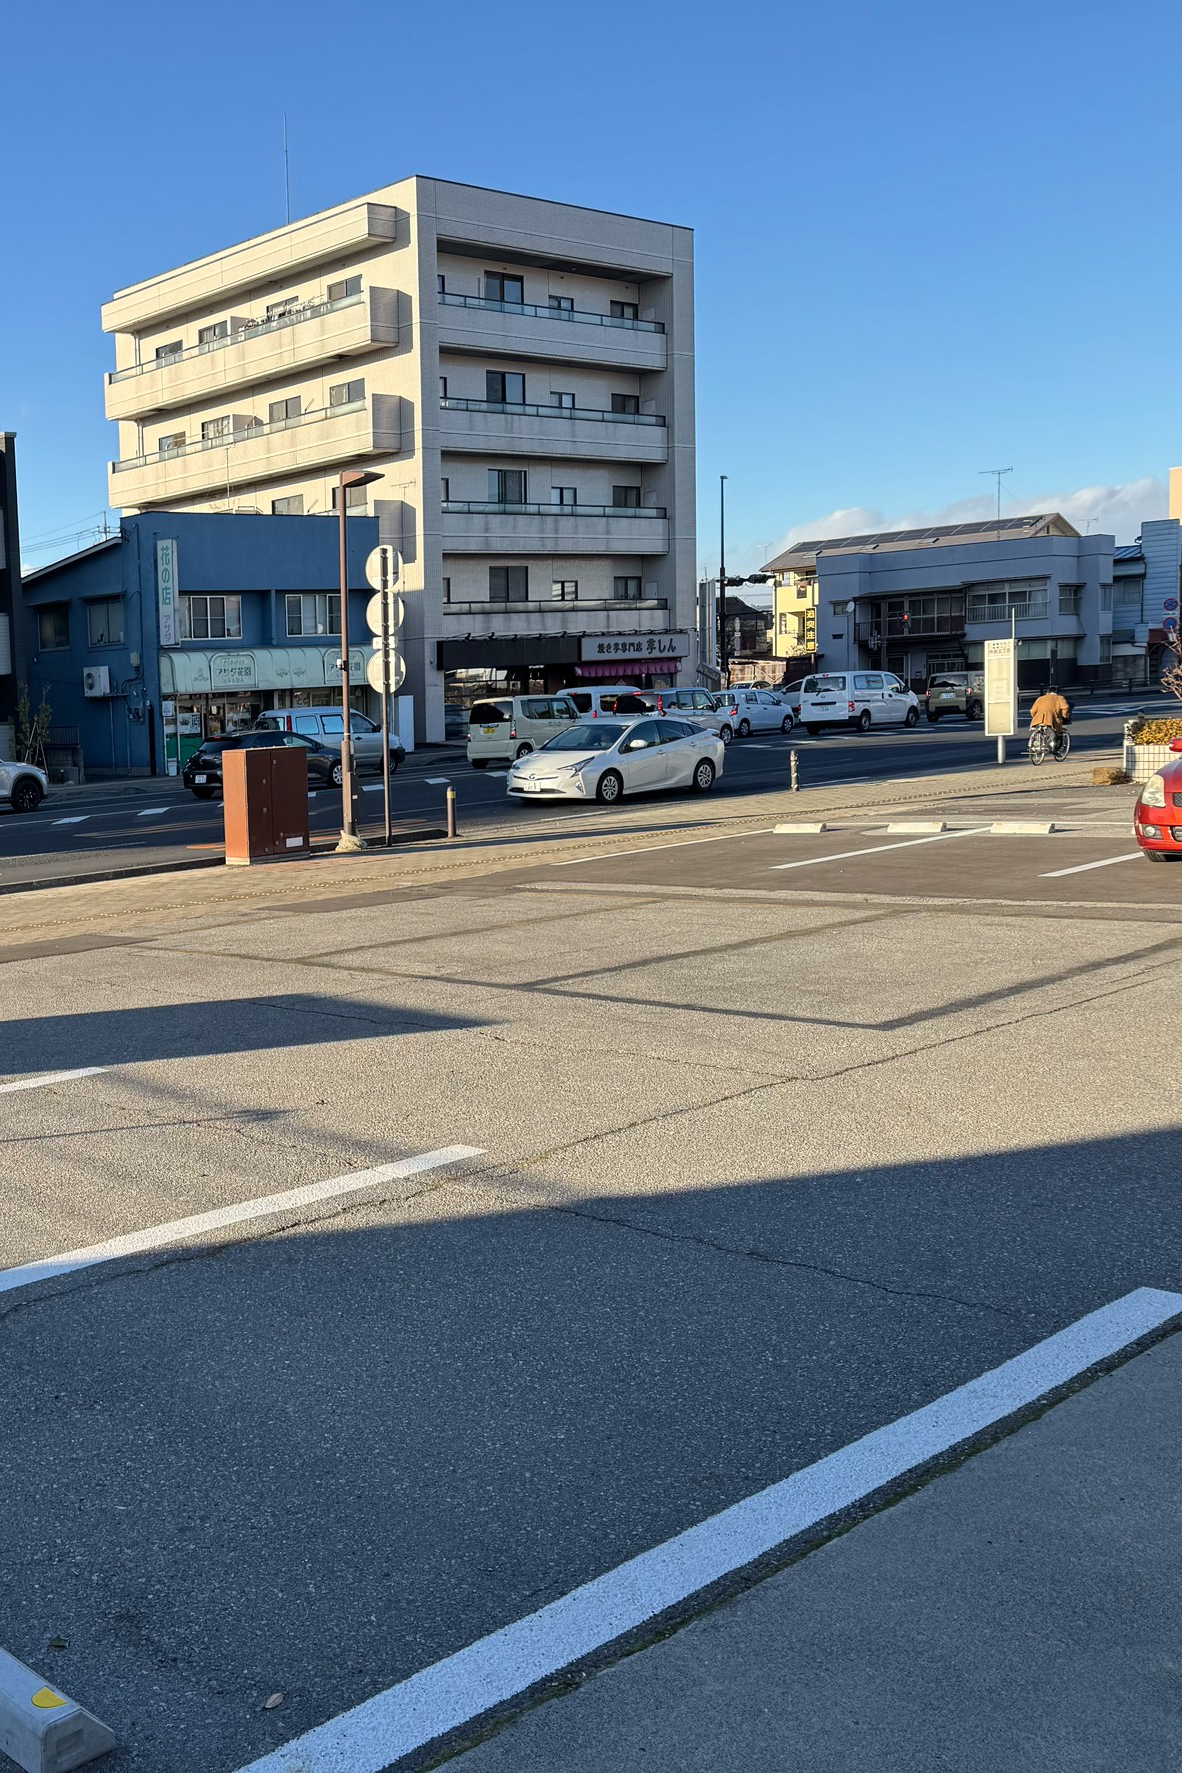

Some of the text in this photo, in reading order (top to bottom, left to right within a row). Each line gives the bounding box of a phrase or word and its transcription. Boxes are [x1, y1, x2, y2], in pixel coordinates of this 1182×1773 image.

[161, 545, 171, 606] 花の店
[163, 614, 172, 643] アサダ
[597, 641, 643, 654] 焼き芋専門店
